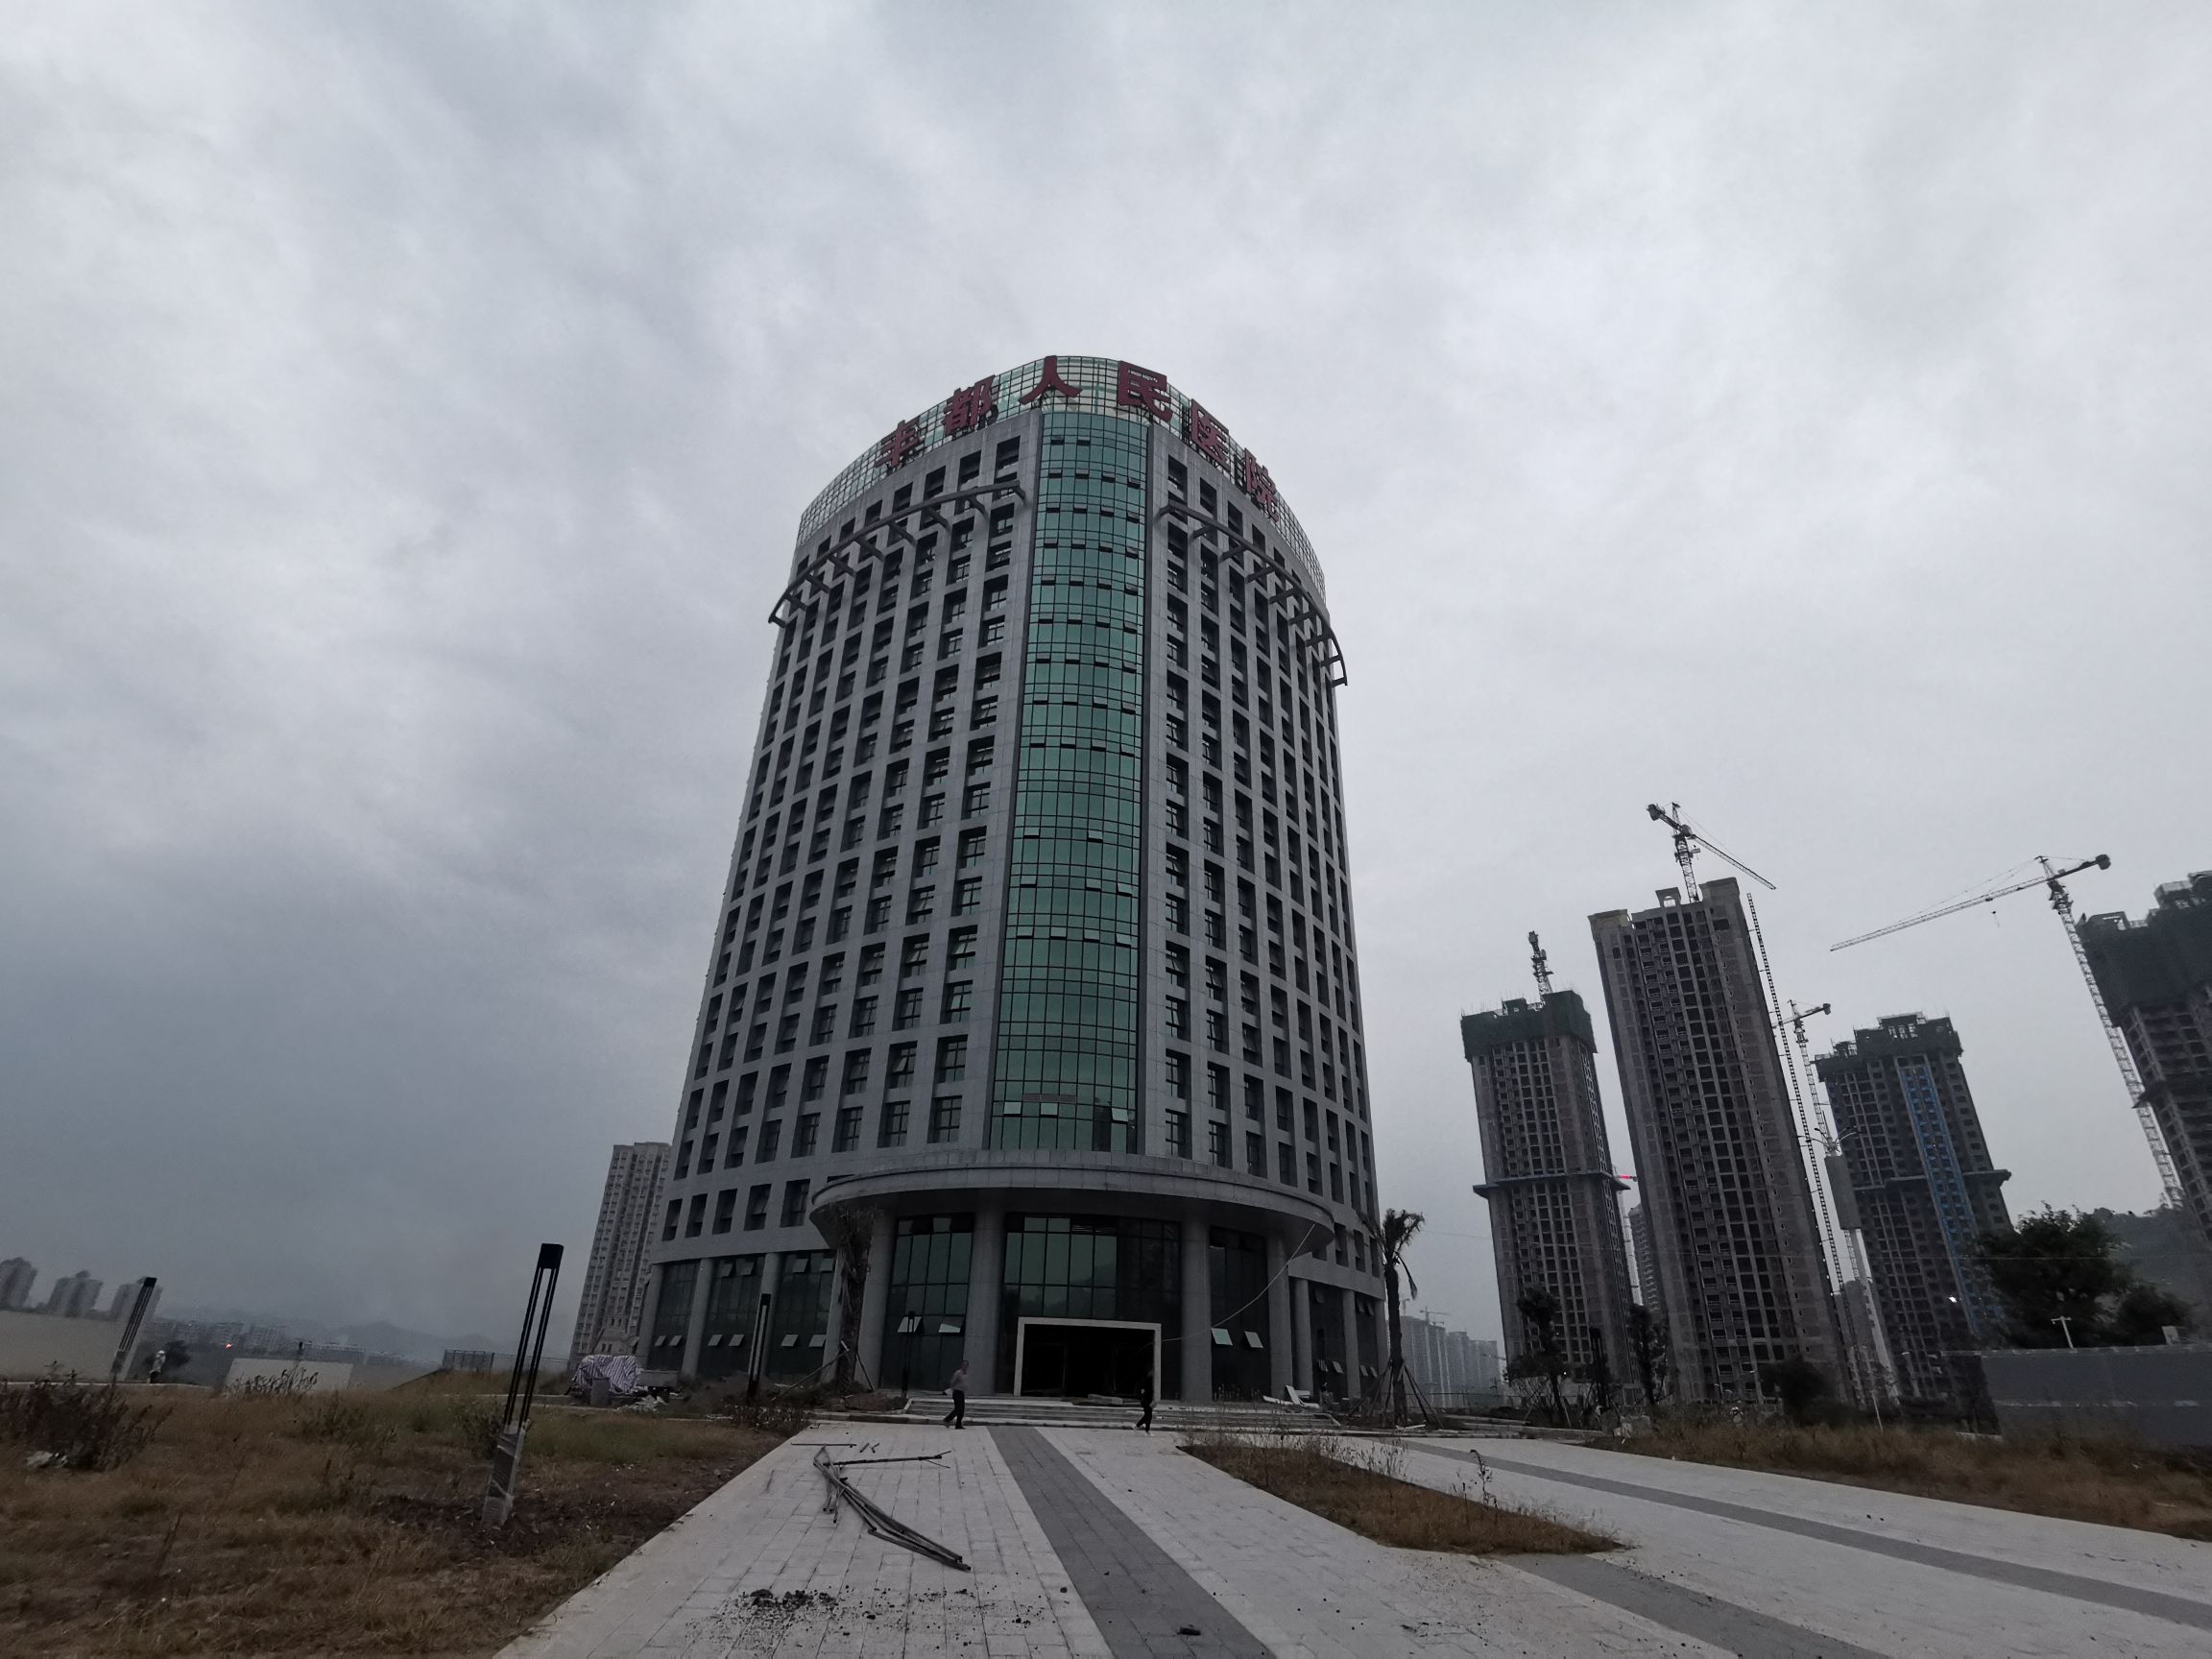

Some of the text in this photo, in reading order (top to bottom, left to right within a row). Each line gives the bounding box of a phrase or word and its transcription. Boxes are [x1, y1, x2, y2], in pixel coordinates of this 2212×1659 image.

[874, 355, 1279, 522] 丰都人民医院
